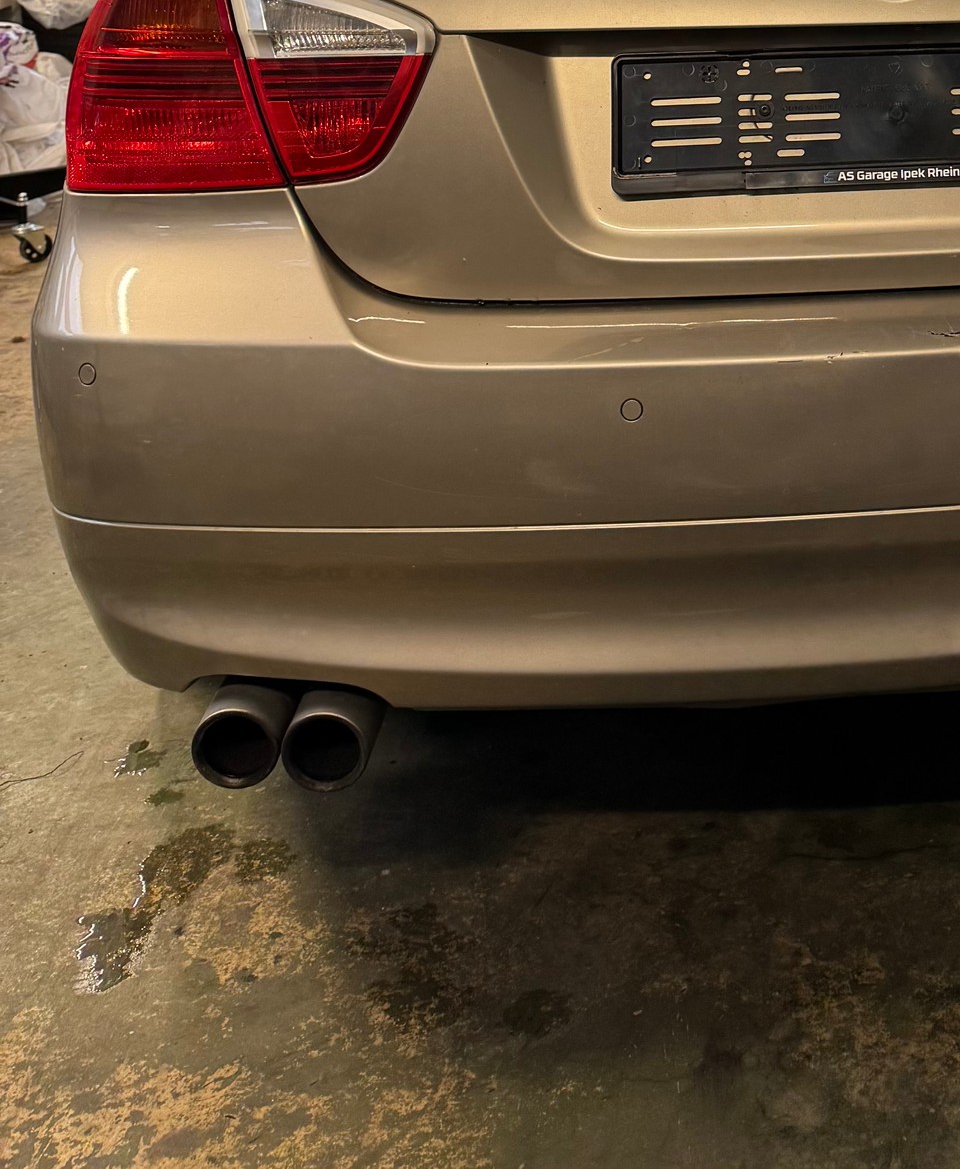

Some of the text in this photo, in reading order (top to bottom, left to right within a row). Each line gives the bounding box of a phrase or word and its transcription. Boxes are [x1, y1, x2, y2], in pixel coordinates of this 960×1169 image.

[838, 171, 854, 181] AS
[856, 169, 898, 181] Garage
[901, 168, 926, 180] Ipek
